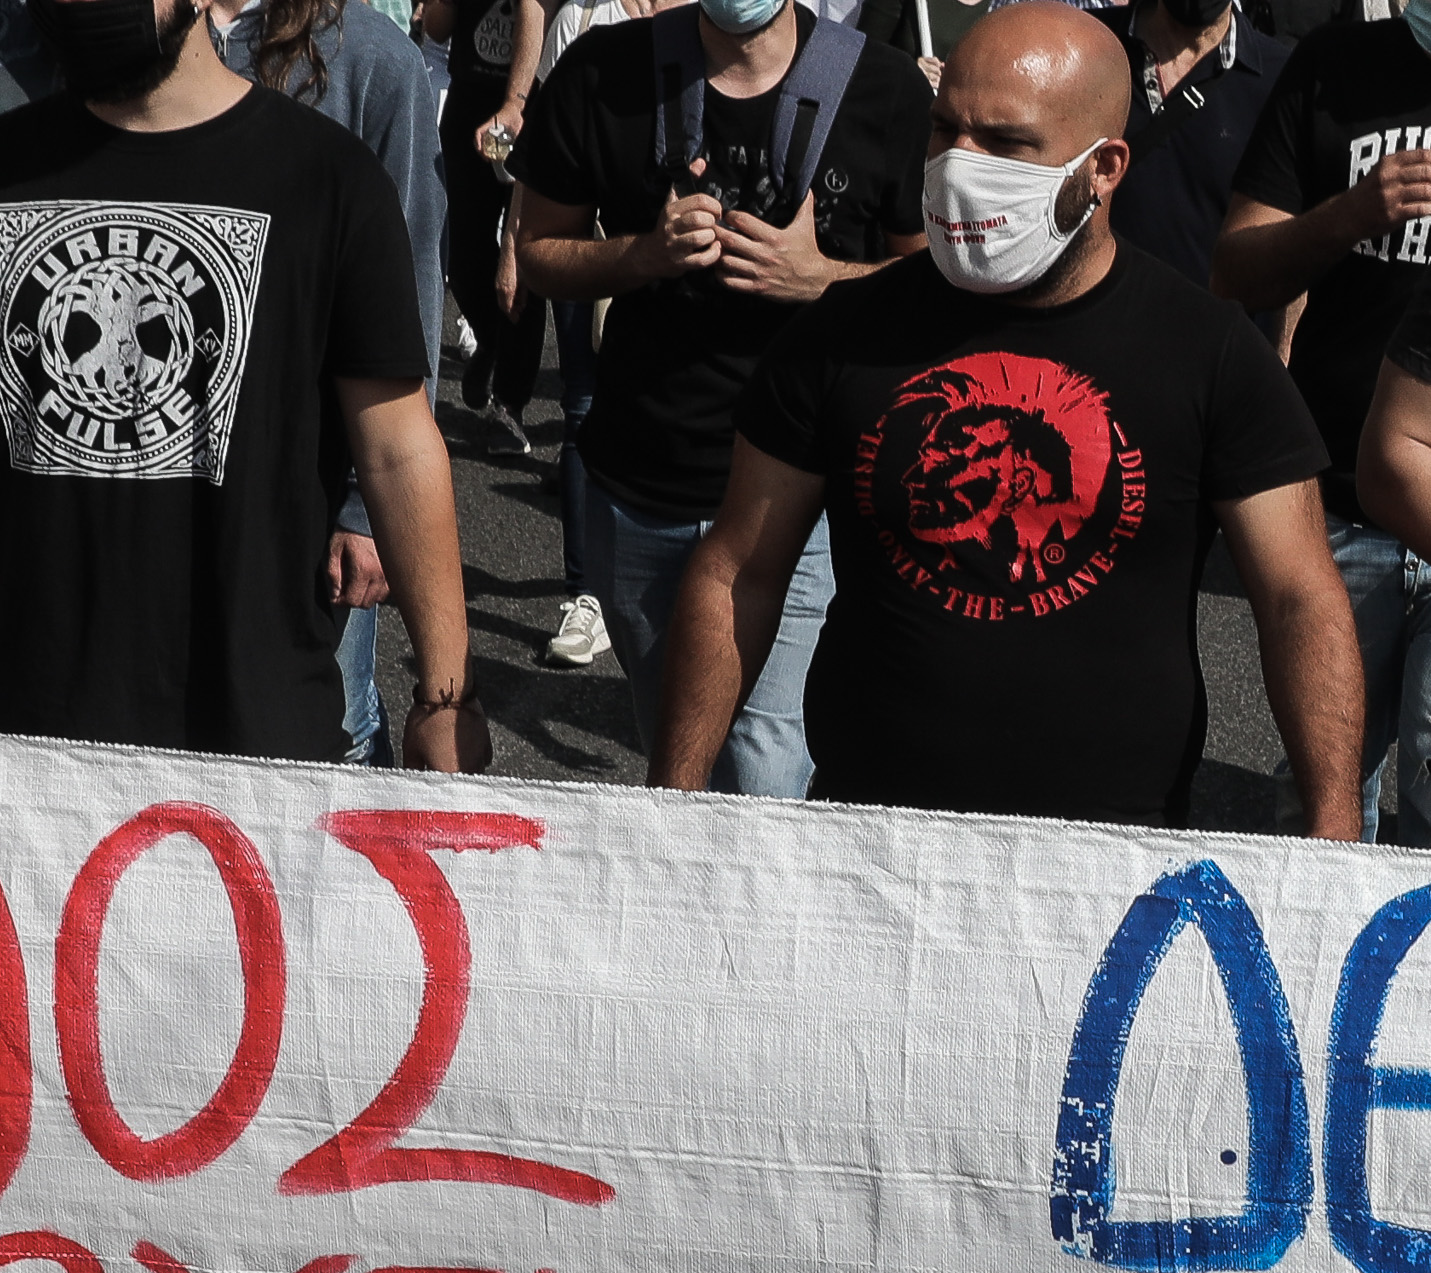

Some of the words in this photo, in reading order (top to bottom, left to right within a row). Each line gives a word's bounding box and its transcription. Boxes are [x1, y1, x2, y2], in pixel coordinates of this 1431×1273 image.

[478, 35, 513, 57] DRO
[31, 227, 206, 298] URBAN
[38, 388, 196, 450] PULSE
[1118, 447, 1147, 541] DIESEL
